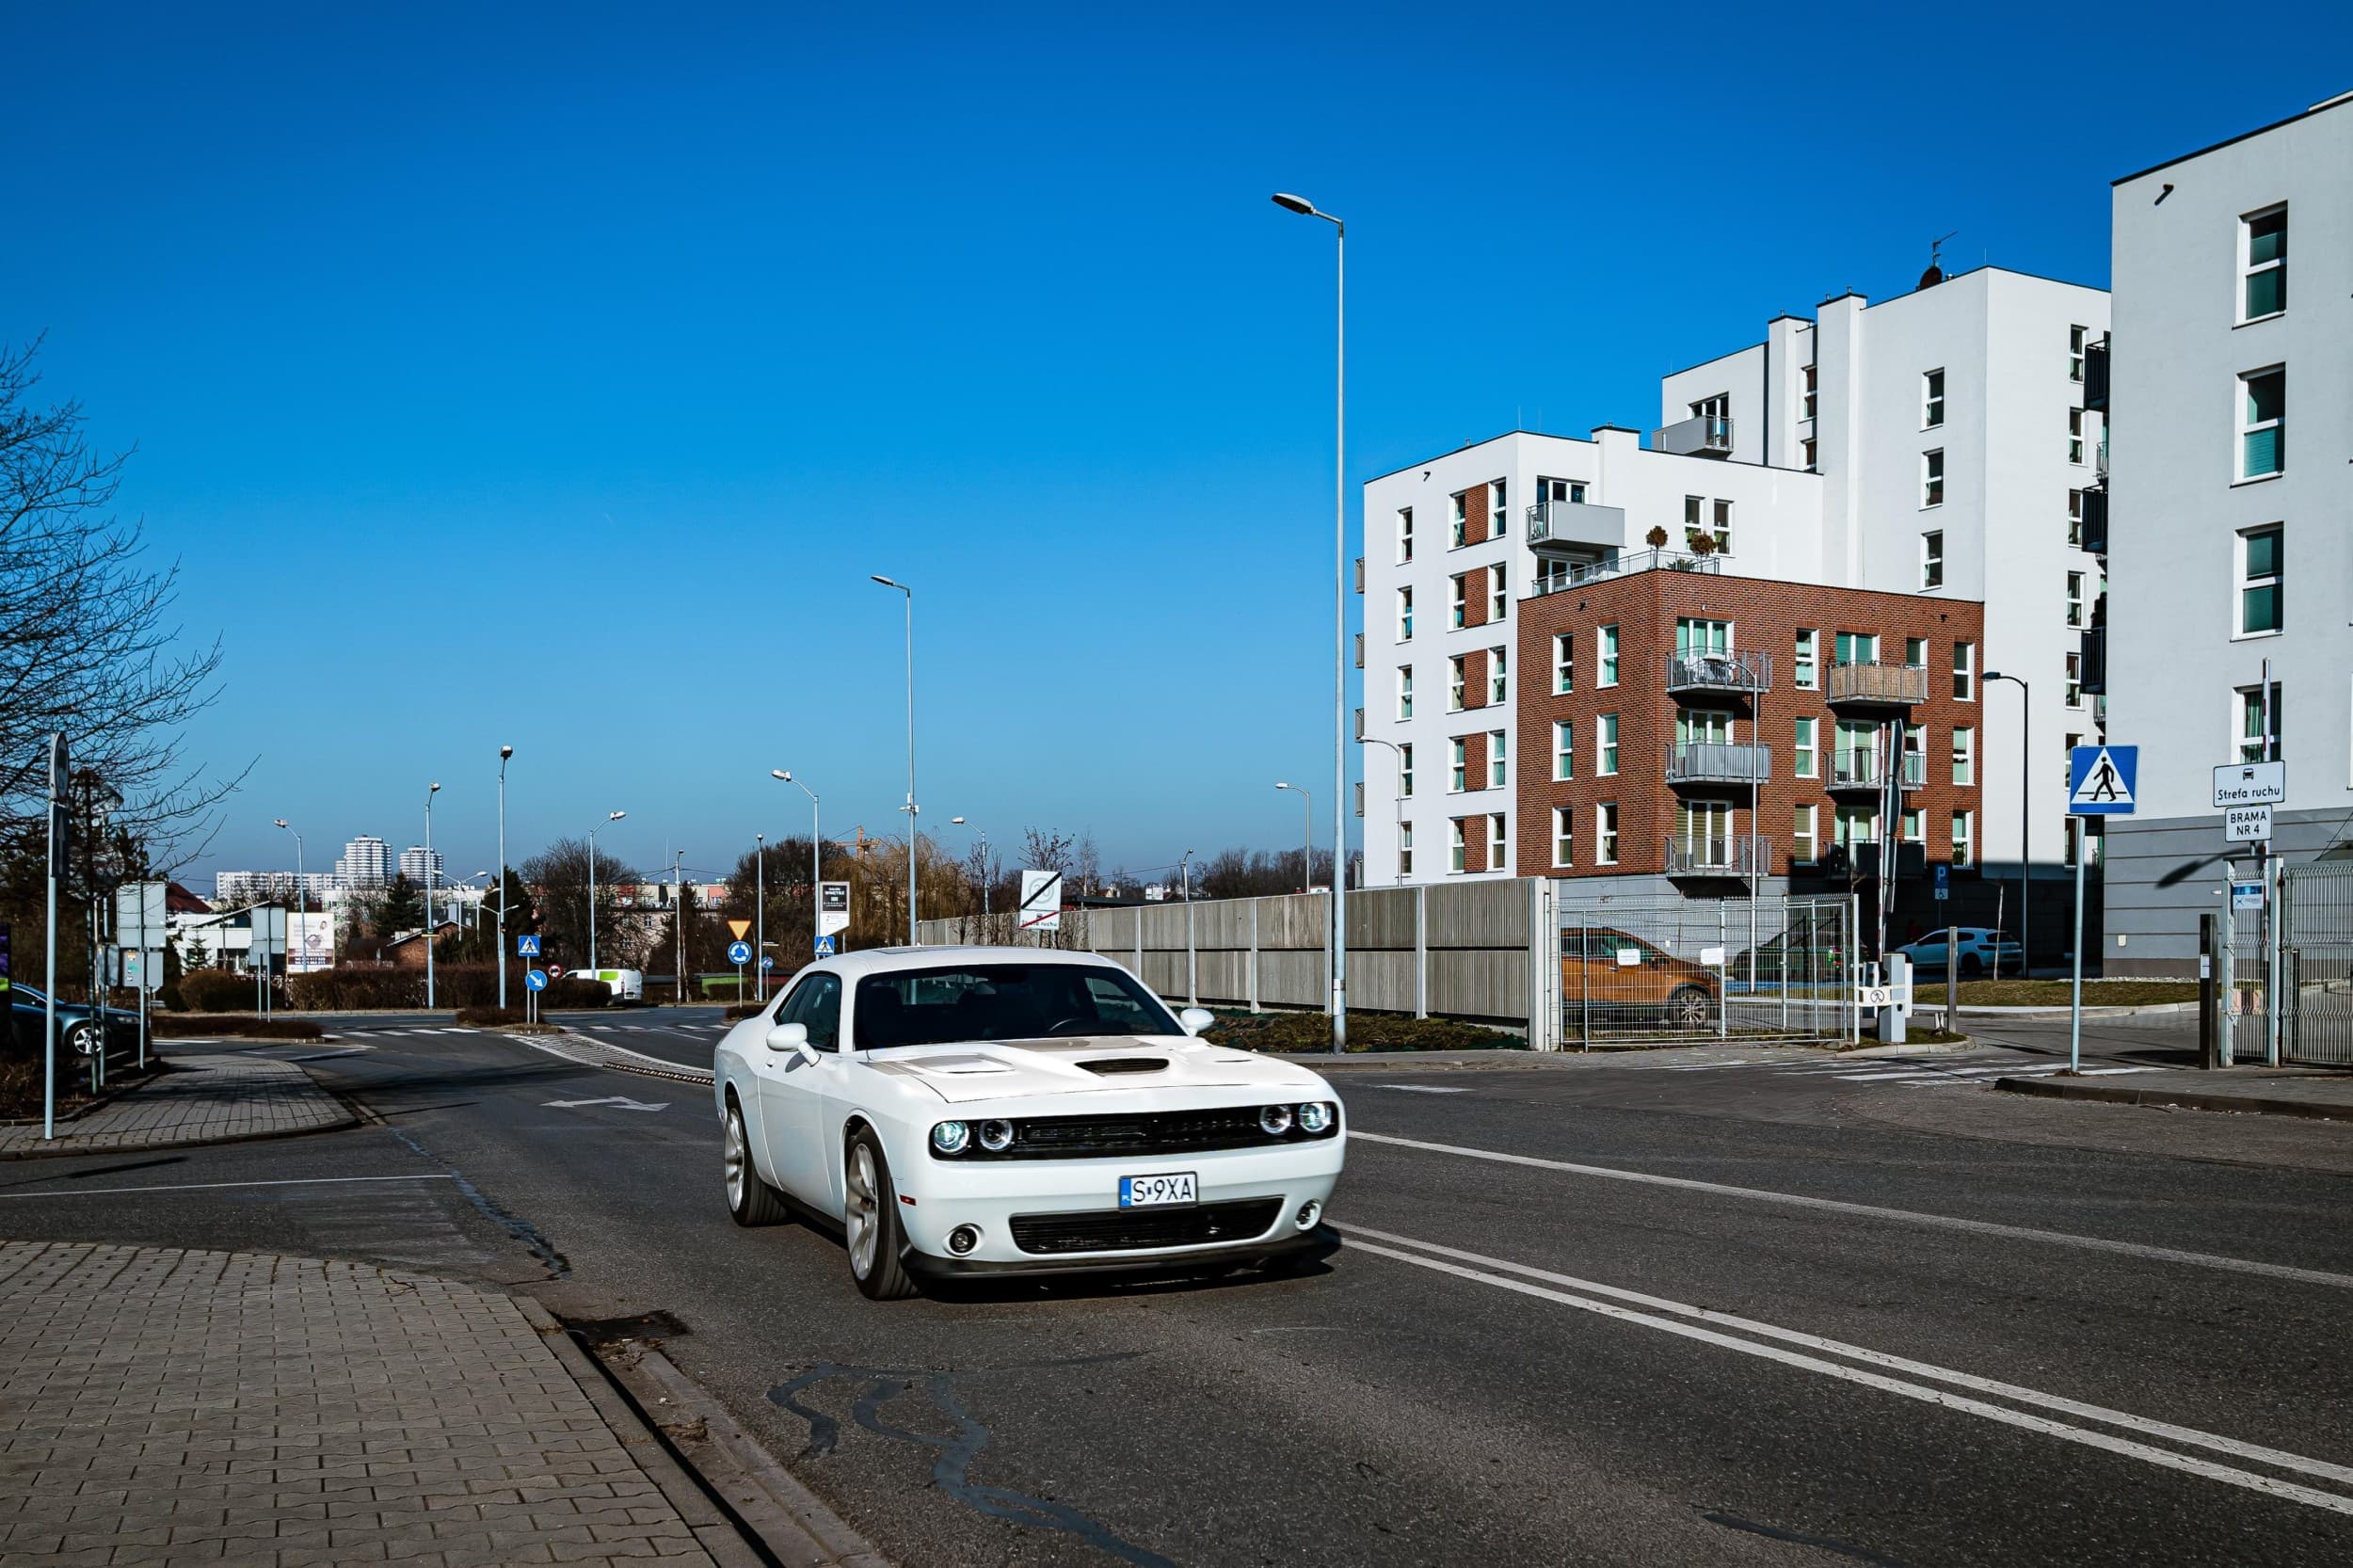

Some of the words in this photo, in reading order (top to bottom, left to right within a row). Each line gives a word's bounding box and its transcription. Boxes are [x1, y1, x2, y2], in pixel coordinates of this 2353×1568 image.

[2217, 788, 2248, 800] Strefa
[2251, 785, 2281, 797] ruchu
[2230, 810, 2267, 824] BRAMA
[2236, 824, 2250, 836] NR
[2253, 824, 2260, 835] 4
[1937, 866, 1946, 881] P
